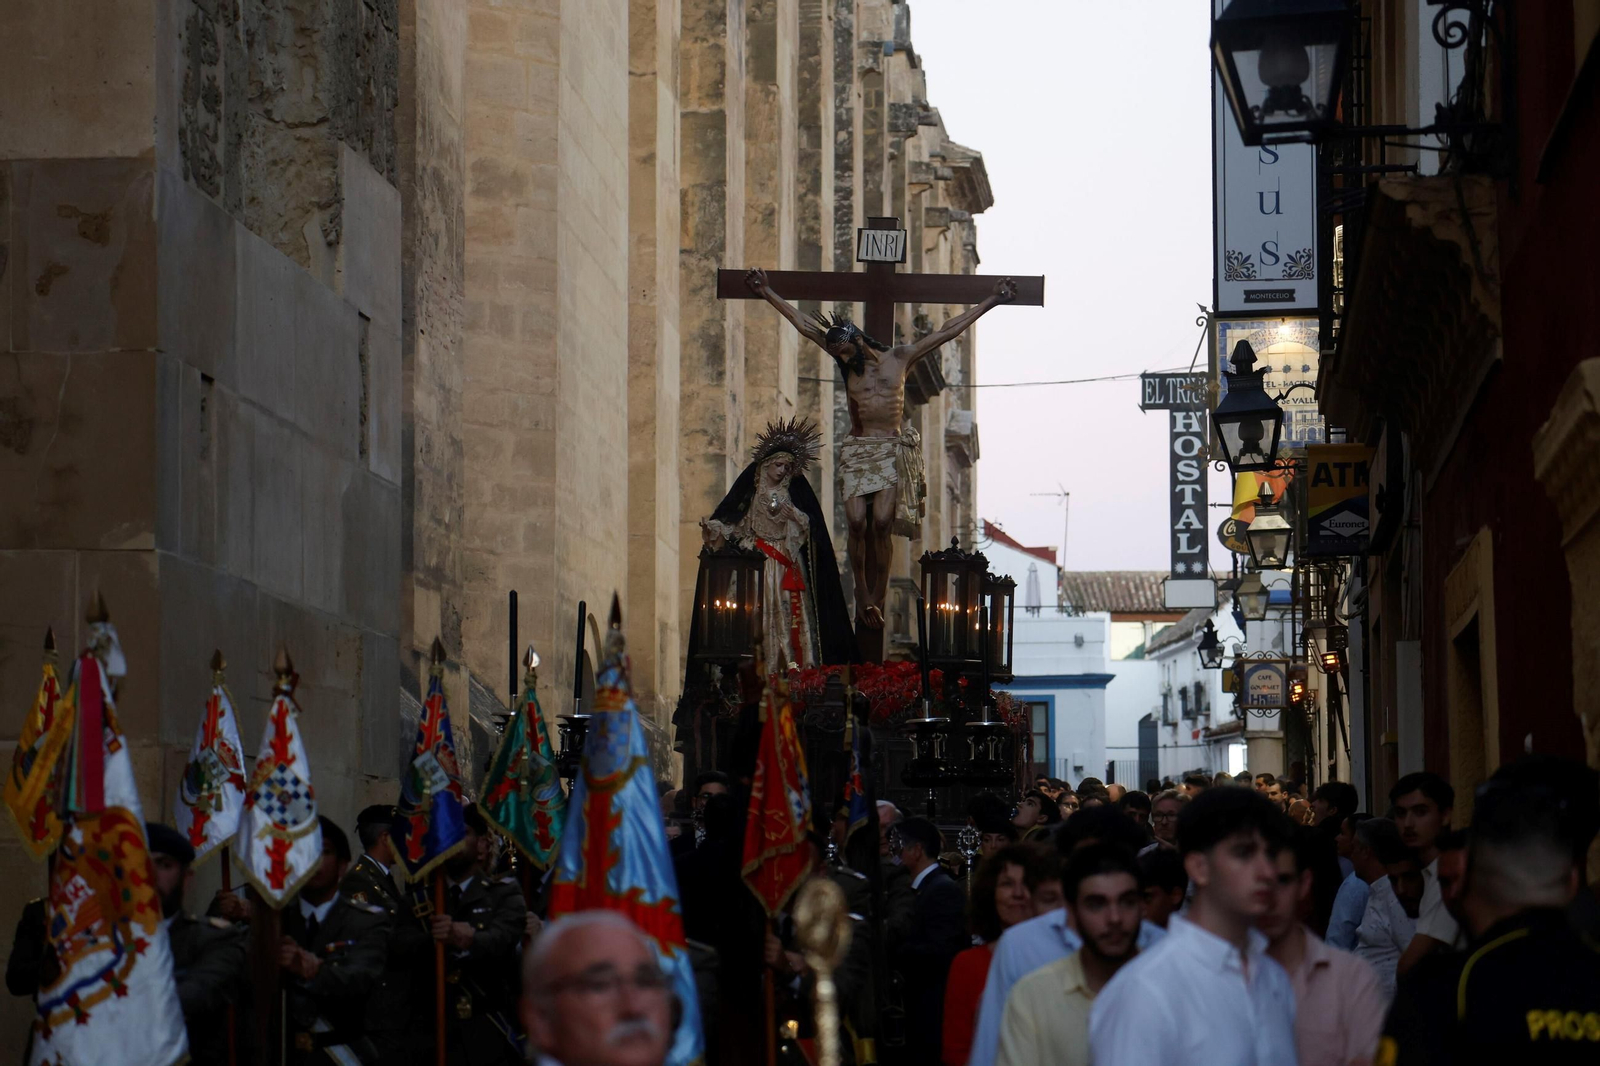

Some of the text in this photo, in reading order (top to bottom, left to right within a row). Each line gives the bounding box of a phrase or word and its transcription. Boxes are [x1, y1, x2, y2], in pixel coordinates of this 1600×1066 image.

[865, 233, 899, 258] INRI
[1249, 292, 1290, 300] MONTECELIO
[1144, 378, 1164, 404] EL
[1292, 397, 1316, 405] VALL
[1172, 411, 1203, 554] HOSTAL
[1329, 519, 1366, 529] Euronet
